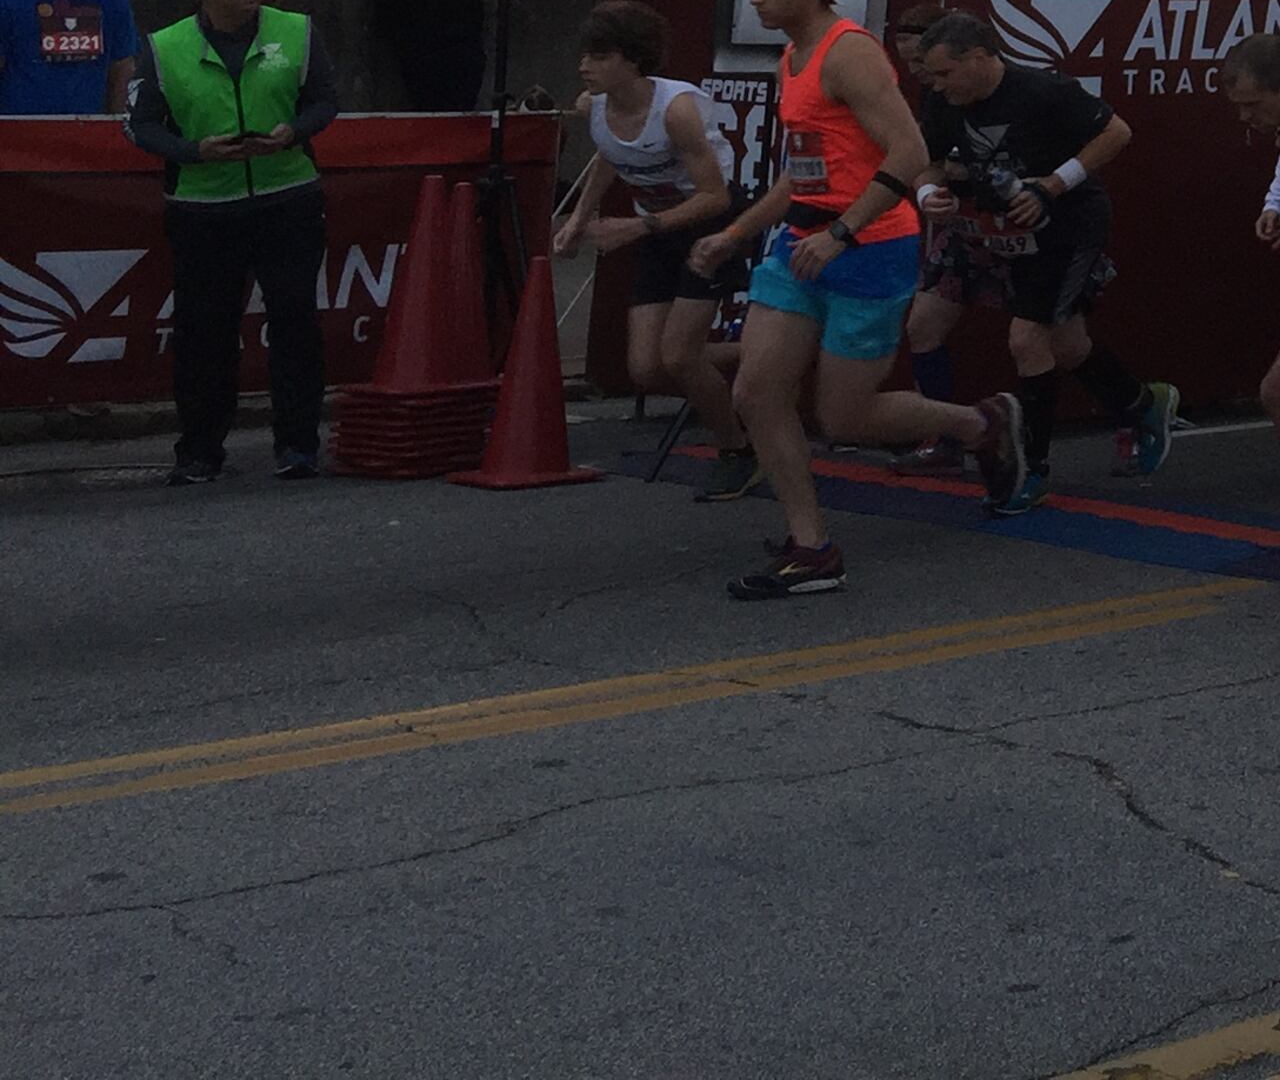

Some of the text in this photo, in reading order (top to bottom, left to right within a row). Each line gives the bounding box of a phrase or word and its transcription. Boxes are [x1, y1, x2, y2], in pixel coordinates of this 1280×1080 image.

[42, 35, 99, 51] G 2321
[701, 78, 768, 102] SPORTS
[1123, 68, 1220, 95] TRAC
